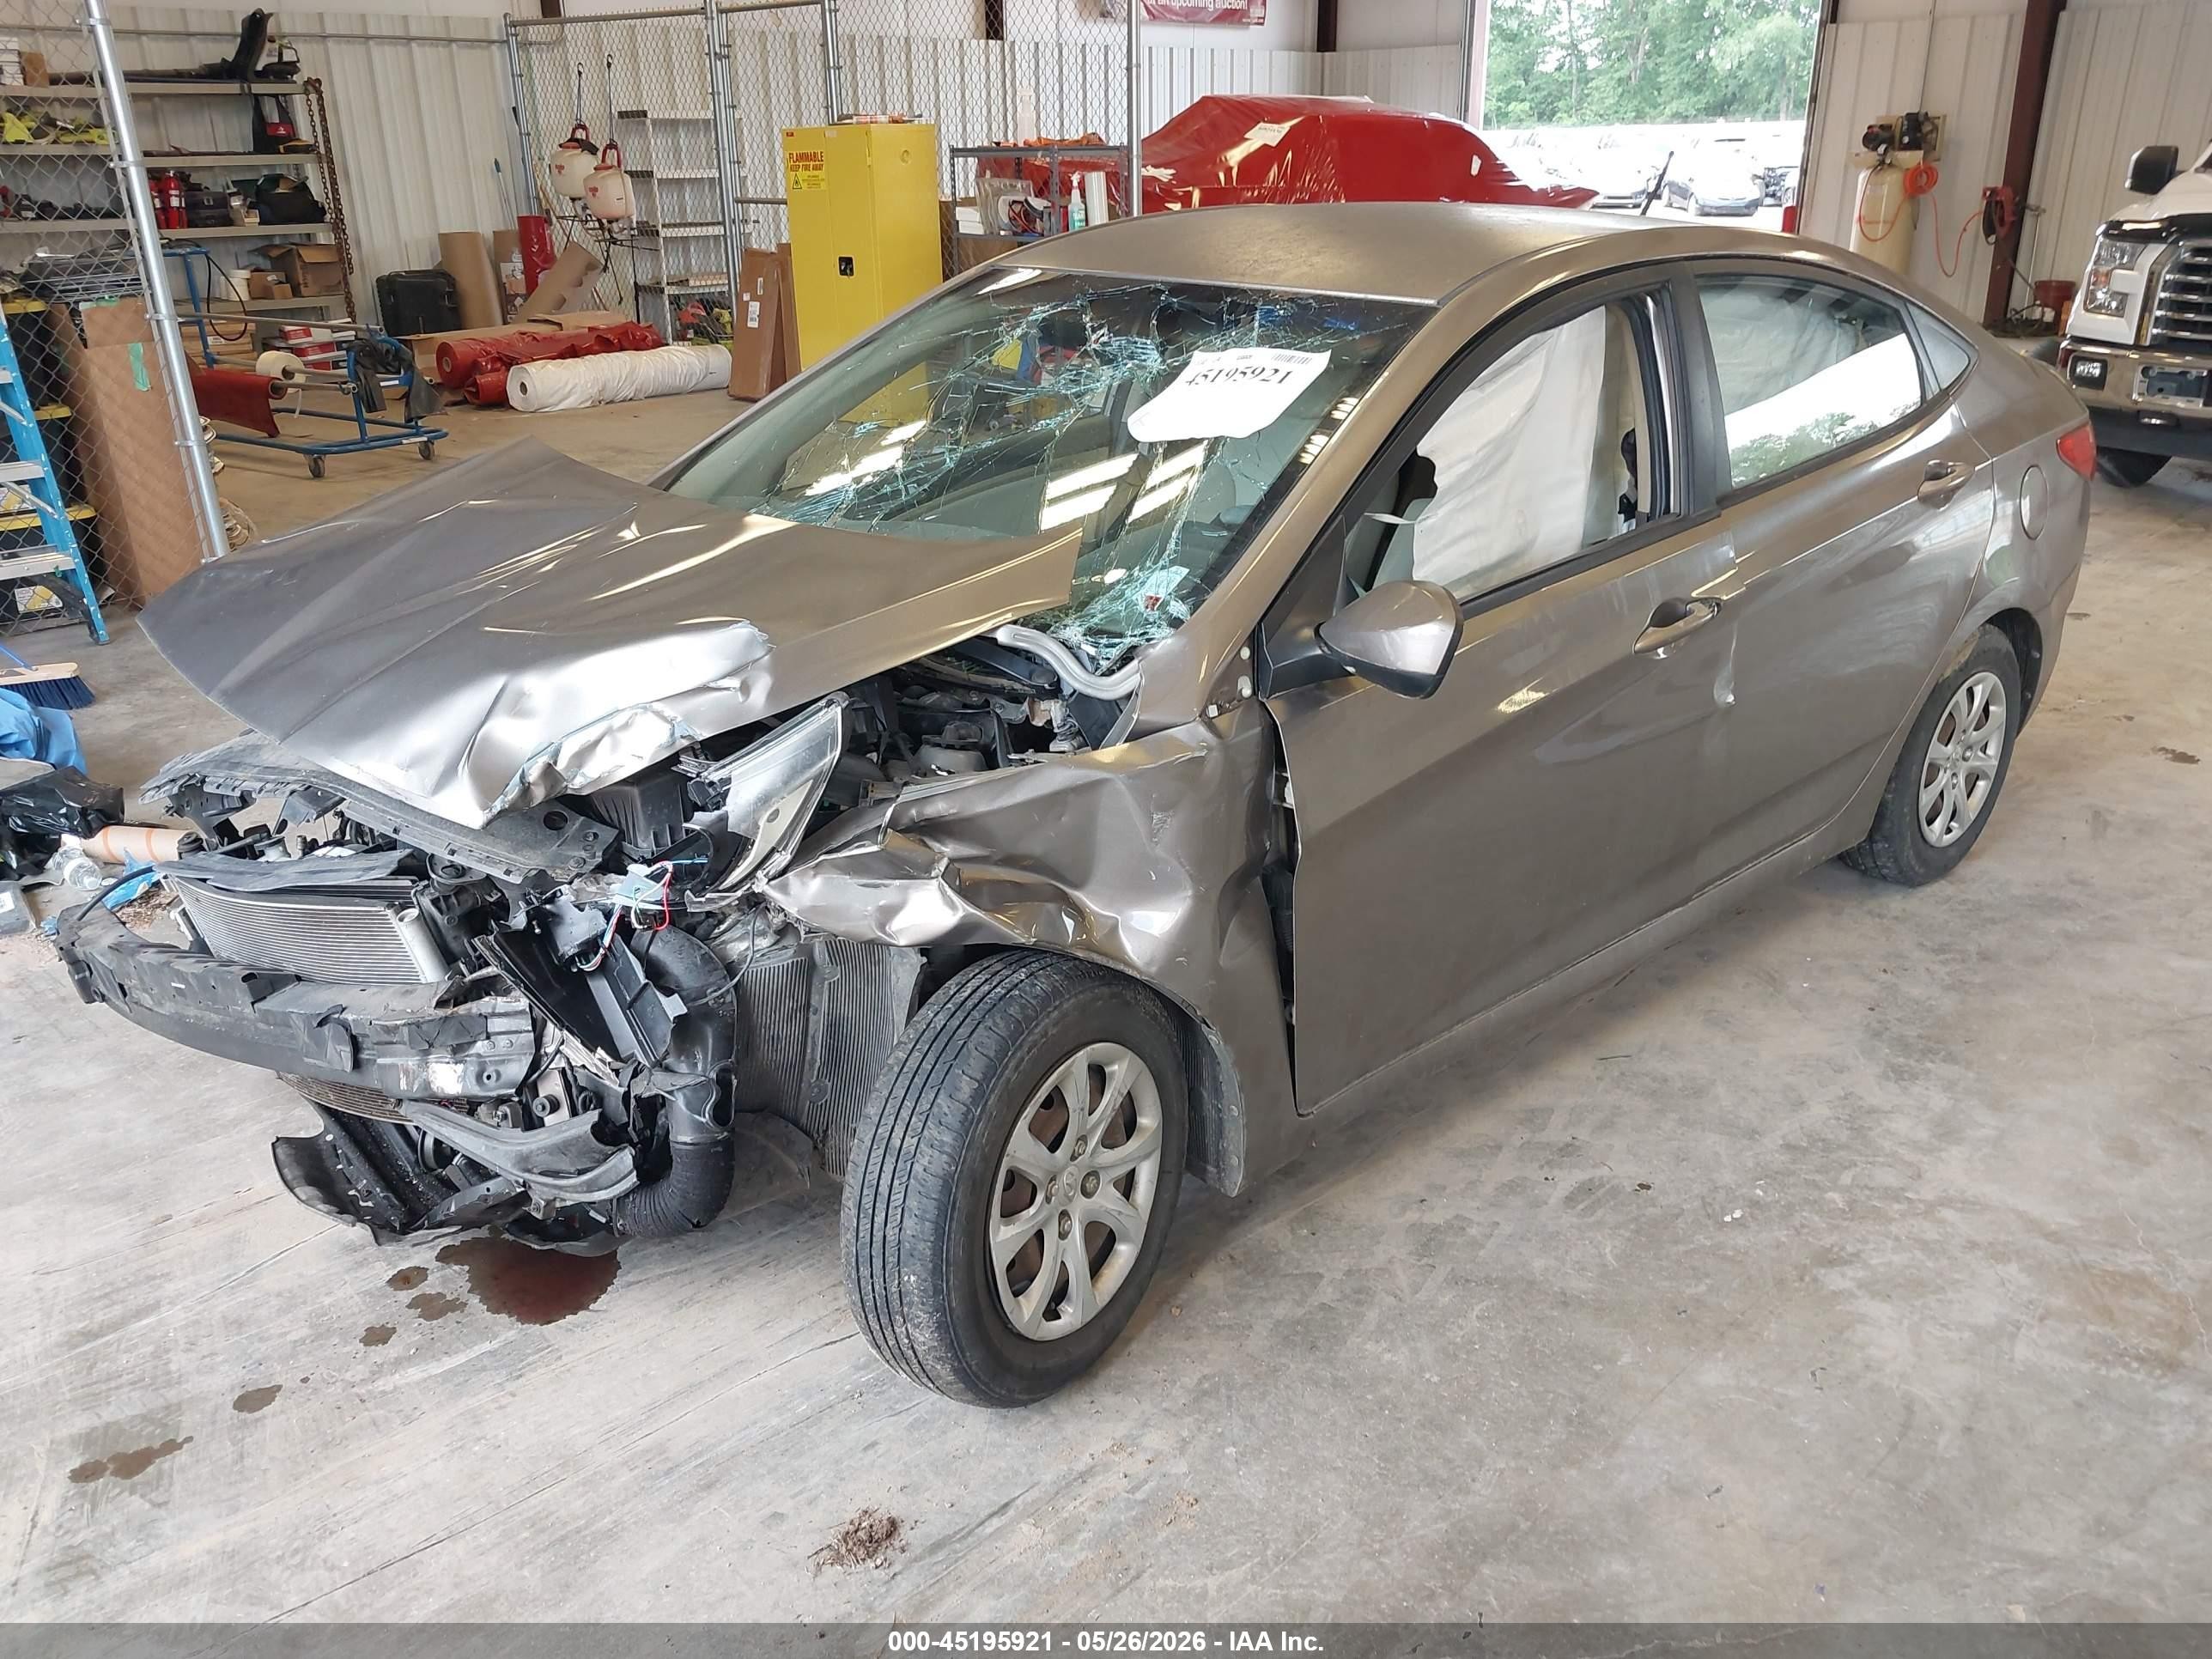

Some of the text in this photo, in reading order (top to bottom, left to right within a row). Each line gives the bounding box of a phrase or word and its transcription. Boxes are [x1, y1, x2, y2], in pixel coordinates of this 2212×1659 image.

[788, 150, 824, 163] FLAMMABLE
[790, 163, 823, 173] KEEP FIRE AWAY
[1185, 366, 1292, 386] 45195921
